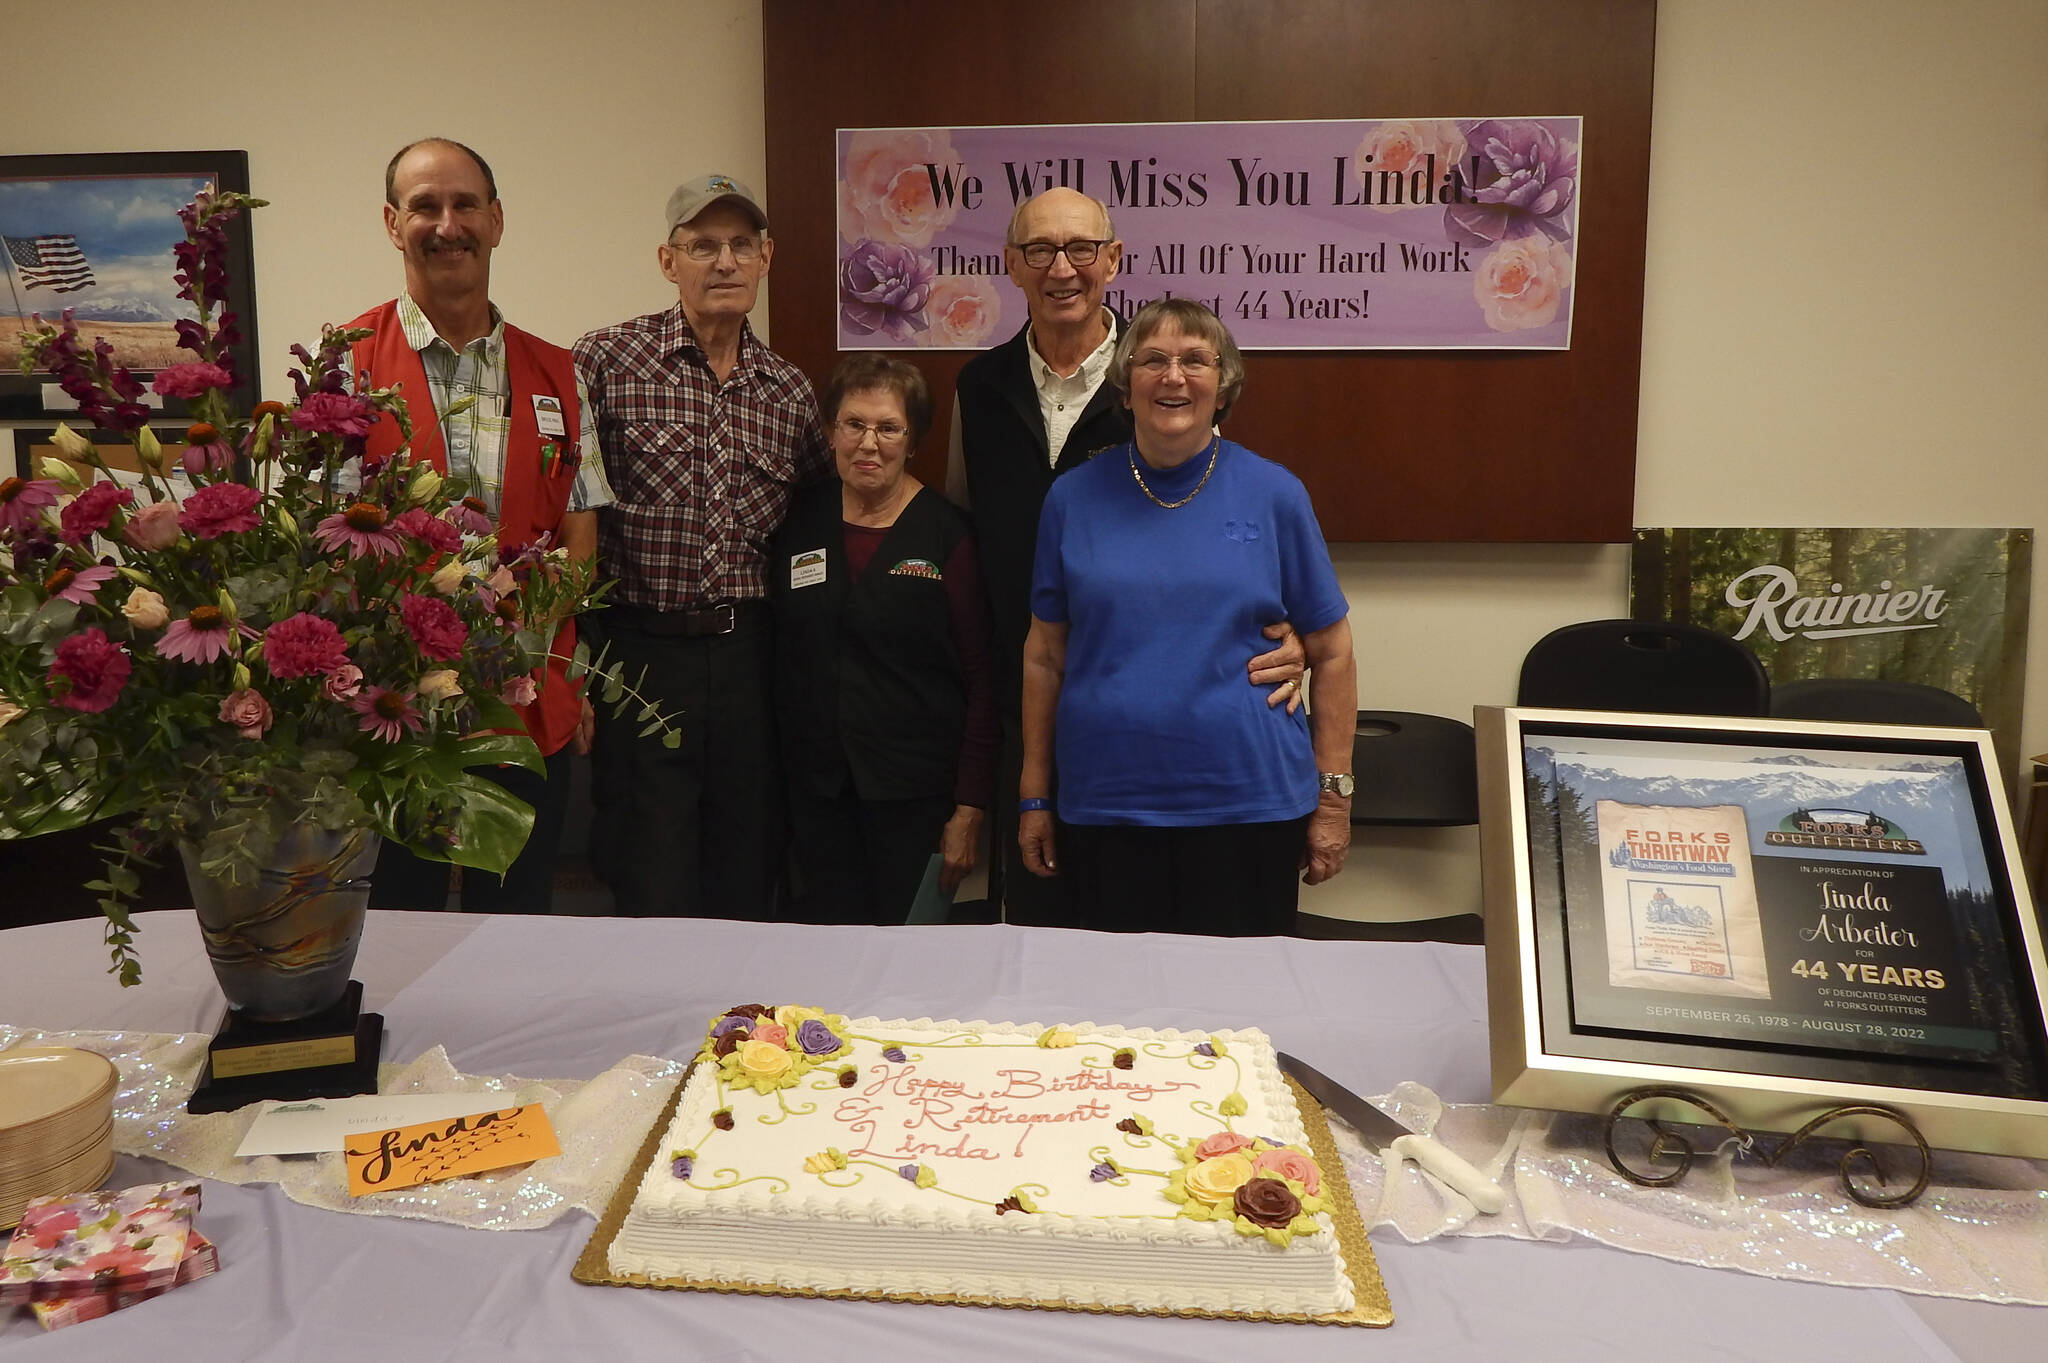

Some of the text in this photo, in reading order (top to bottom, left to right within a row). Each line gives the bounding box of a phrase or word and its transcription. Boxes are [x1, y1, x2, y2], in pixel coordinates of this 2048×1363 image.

[924, 162, 983, 210] We
[1108, 157, 1208, 207] Miss
[1227, 157, 1310, 206] You
[1332, 153, 1481, 205] Linda!
[1148, 243, 1186, 275] All
[1200, 243, 1234, 275] Of
[1240, 244, 1307, 275] Your
[1317, 242, 1386, 274] Hard
[1400, 241, 1473, 273] Work
[1235, 290, 1269, 320] 44
[1281, 289, 1369, 321] Years!
[1725, 564, 1948, 642] Rainier
[1625, 829, 1732, 844] FORKS
[1772, 832, 1918, 852] OUTFITTERS
[1800, 821, 1886, 839] FORKS
[1627, 841, 1730, 863] THRIFTWAY
[1631, 860, 1731, 874] Washington's Food Store
[1799, 865, 1896, 879] IN APPRECIATION OF
[1816, 881, 1893, 912] Linda
[1799, 913, 1919, 948] Arbeiter
[1855, 950, 1875, 958] FOR
[1791, 959, 1946, 989] 44 YEARS
[1817, 987, 1928, 1004] OF DEDICATED SERVICE
[1823, 999, 1927, 1016] AT FORKS OUTFITTERS
[1645, 1005, 1731, 1022] SEPTEMBER
[1758, 1015, 1790, 1028] 1978
[1801, 1019, 1863, 1033] AUGUST
[1890, 1027, 1926, 1040] 2022
[863, 1064, 1201, 1101] Happy Birthday
[833, 1097, 1111, 1132] & Retirement
[347, 1107, 524, 1185] Linda
